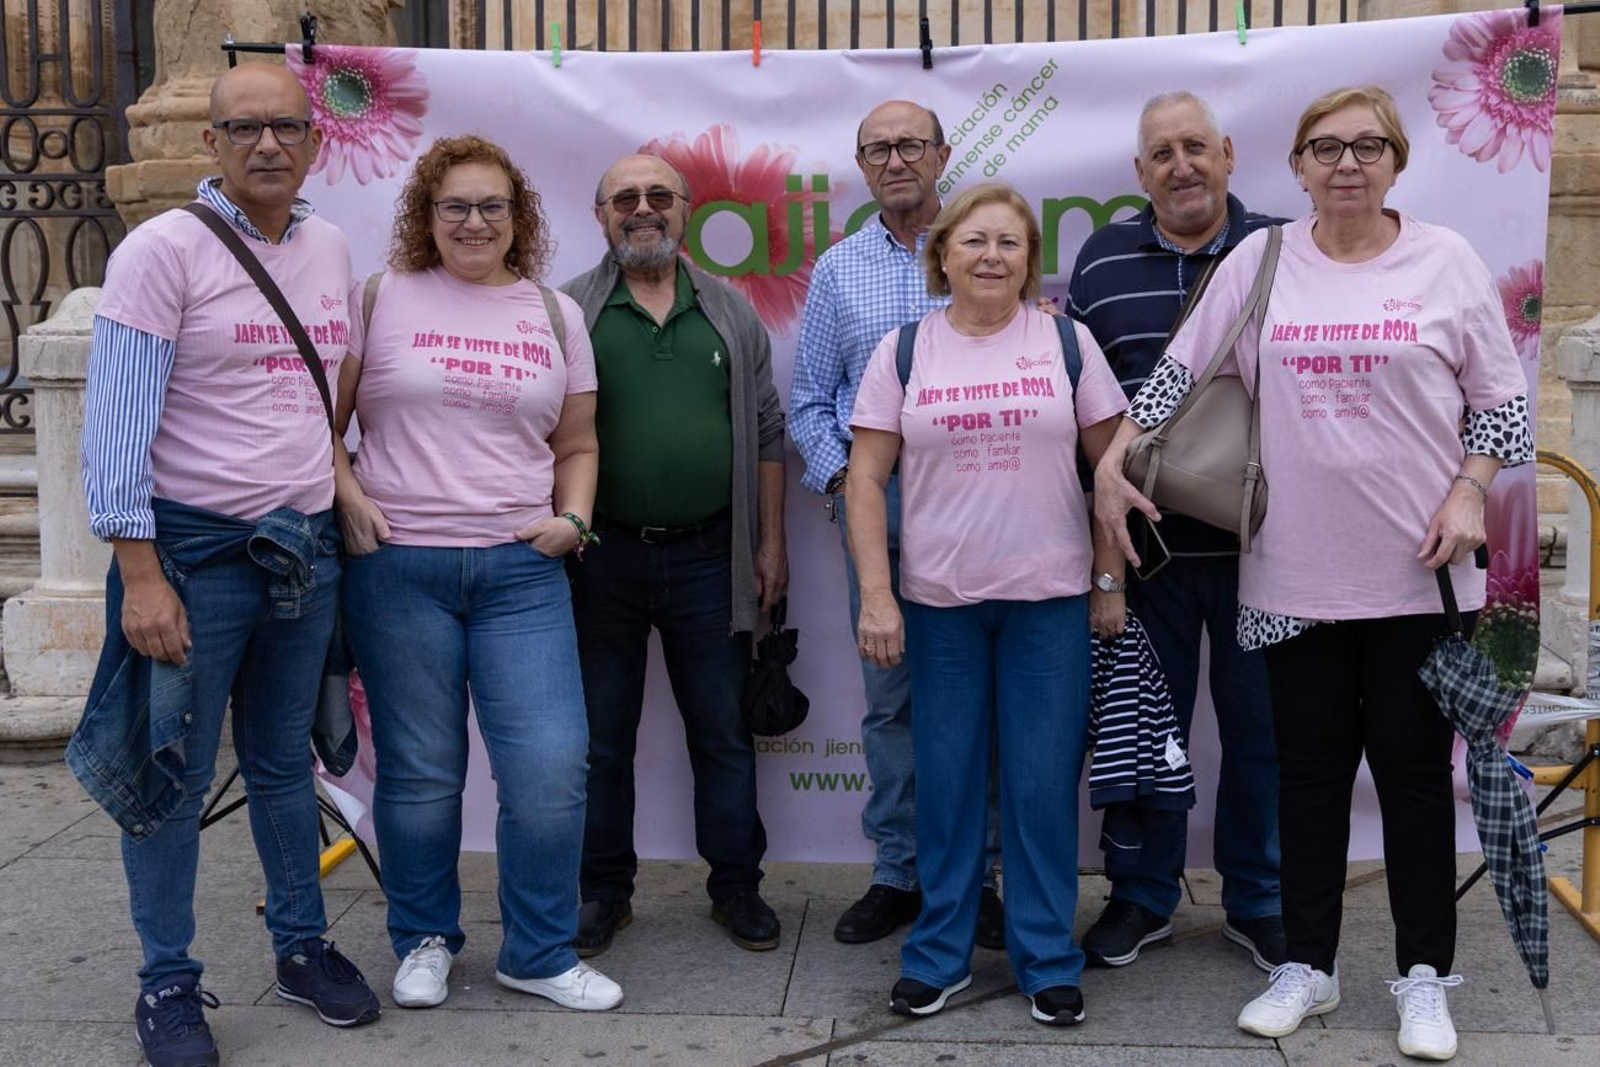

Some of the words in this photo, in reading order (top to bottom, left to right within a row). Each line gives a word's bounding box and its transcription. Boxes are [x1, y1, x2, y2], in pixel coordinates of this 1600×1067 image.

[949, 83, 1008, 146] ciación
[937, 125, 1003, 197] ennense
[1003, 58, 1059, 123] cáncer
[983, 153, 1006, 177] de
[1006, 95, 1059, 153] mama
[234, 319, 265, 344] JAÉN
[267, 325, 279, 344] SE
[314, 325, 330, 344] DE
[1270, 321, 1302, 342] JAÉN
[1303, 325, 1318, 342] SE
[1322, 324, 1358, 342] VISTE
[1362, 324, 1380, 341] DE
[1383, 319, 1418, 343] ROSA
[412, 329, 444, 348] JAÉN
[447, 335, 461, 349] SE
[465, 338, 500, 354] VISTE
[504, 343, 520, 358] DE
[522, 341, 552, 370] ROSA
[271, 375, 296, 385] como
[444, 374, 473, 386] como
[1299, 379, 1326, 390] como
[271, 389, 297, 399] como
[443, 386, 472, 397] como
[915, 386, 942, 407] JAÉN
[946, 387, 960, 402] SE
[963, 383, 999, 401] VISTE
[1002, 381, 1019, 398] DE
[1020, 377, 1056, 398] ROSA
[1300, 394, 1326, 404] como
[1336, 390, 1372, 404] familiar
[272, 403, 298, 413] como
[442, 398, 471, 409] como
[1301, 408, 1327, 419] como
[951, 435, 977, 446] como
[953, 449, 979, 460] como
[987, 443, 1021, 456] familiar
[956, 461, 981, 472] como
[756, 737, 814, 754] ación
[825, 738, 866, 758] jien
[789, 772, 873, 792] www.
[158, 985, 181, 1000] FILA
